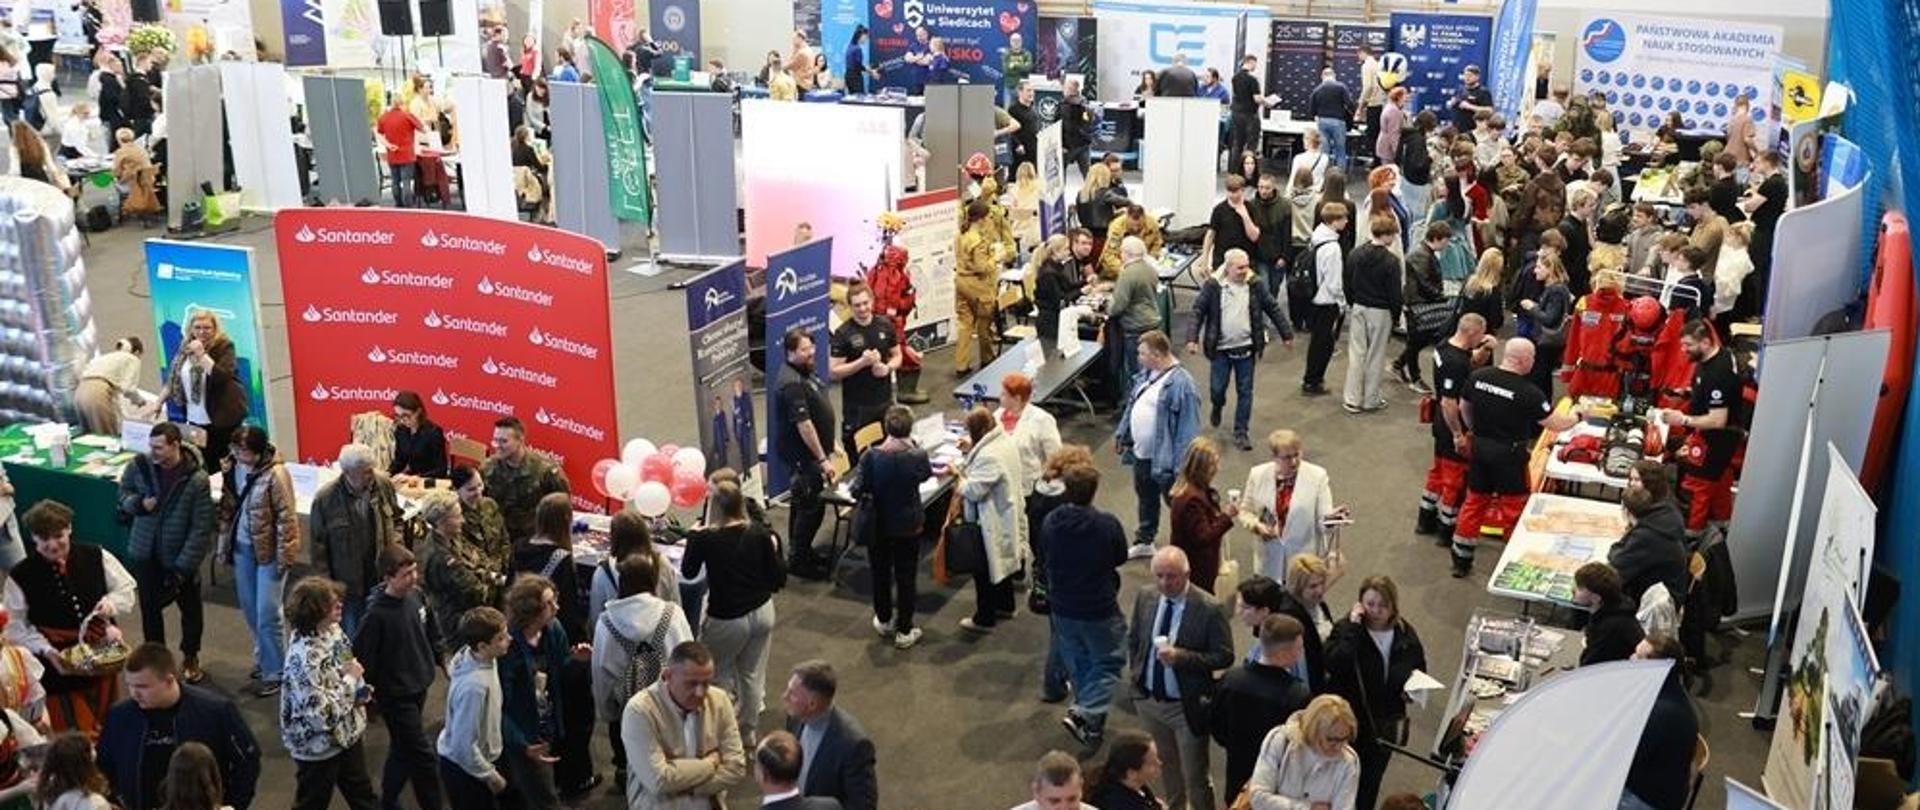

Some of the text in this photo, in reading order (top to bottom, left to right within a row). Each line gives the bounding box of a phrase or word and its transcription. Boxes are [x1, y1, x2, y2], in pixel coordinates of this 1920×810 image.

[926, 3, 995, 17] Uniwersytet
[927, 18, 936, 26] w
[1636, 25, 1776, 45] PAŃSTWOWA AKADEMIA
[1643, 39, 1765, 59] NAUK STOSOWANYCH
[318, 228, 395, 245] Santander
[440, 233, 507, 255] Santander
[543, 249, 594, 275] Santander
[382, 271, 454, 289] Santander
[494, 282, 554, 306] Santander
[323, 307, 399, 324] Santander
[443, 315, 508, 337] Santander
[544, 333, 599, 359] Santander
[388, 350, 459, 368] Santander
[499, 362, 557, 387] Santander
[331, 386, 400, 401] Santande
[450, 392, 515, 415] Santander
[549, 413, 605, 441] Santander
